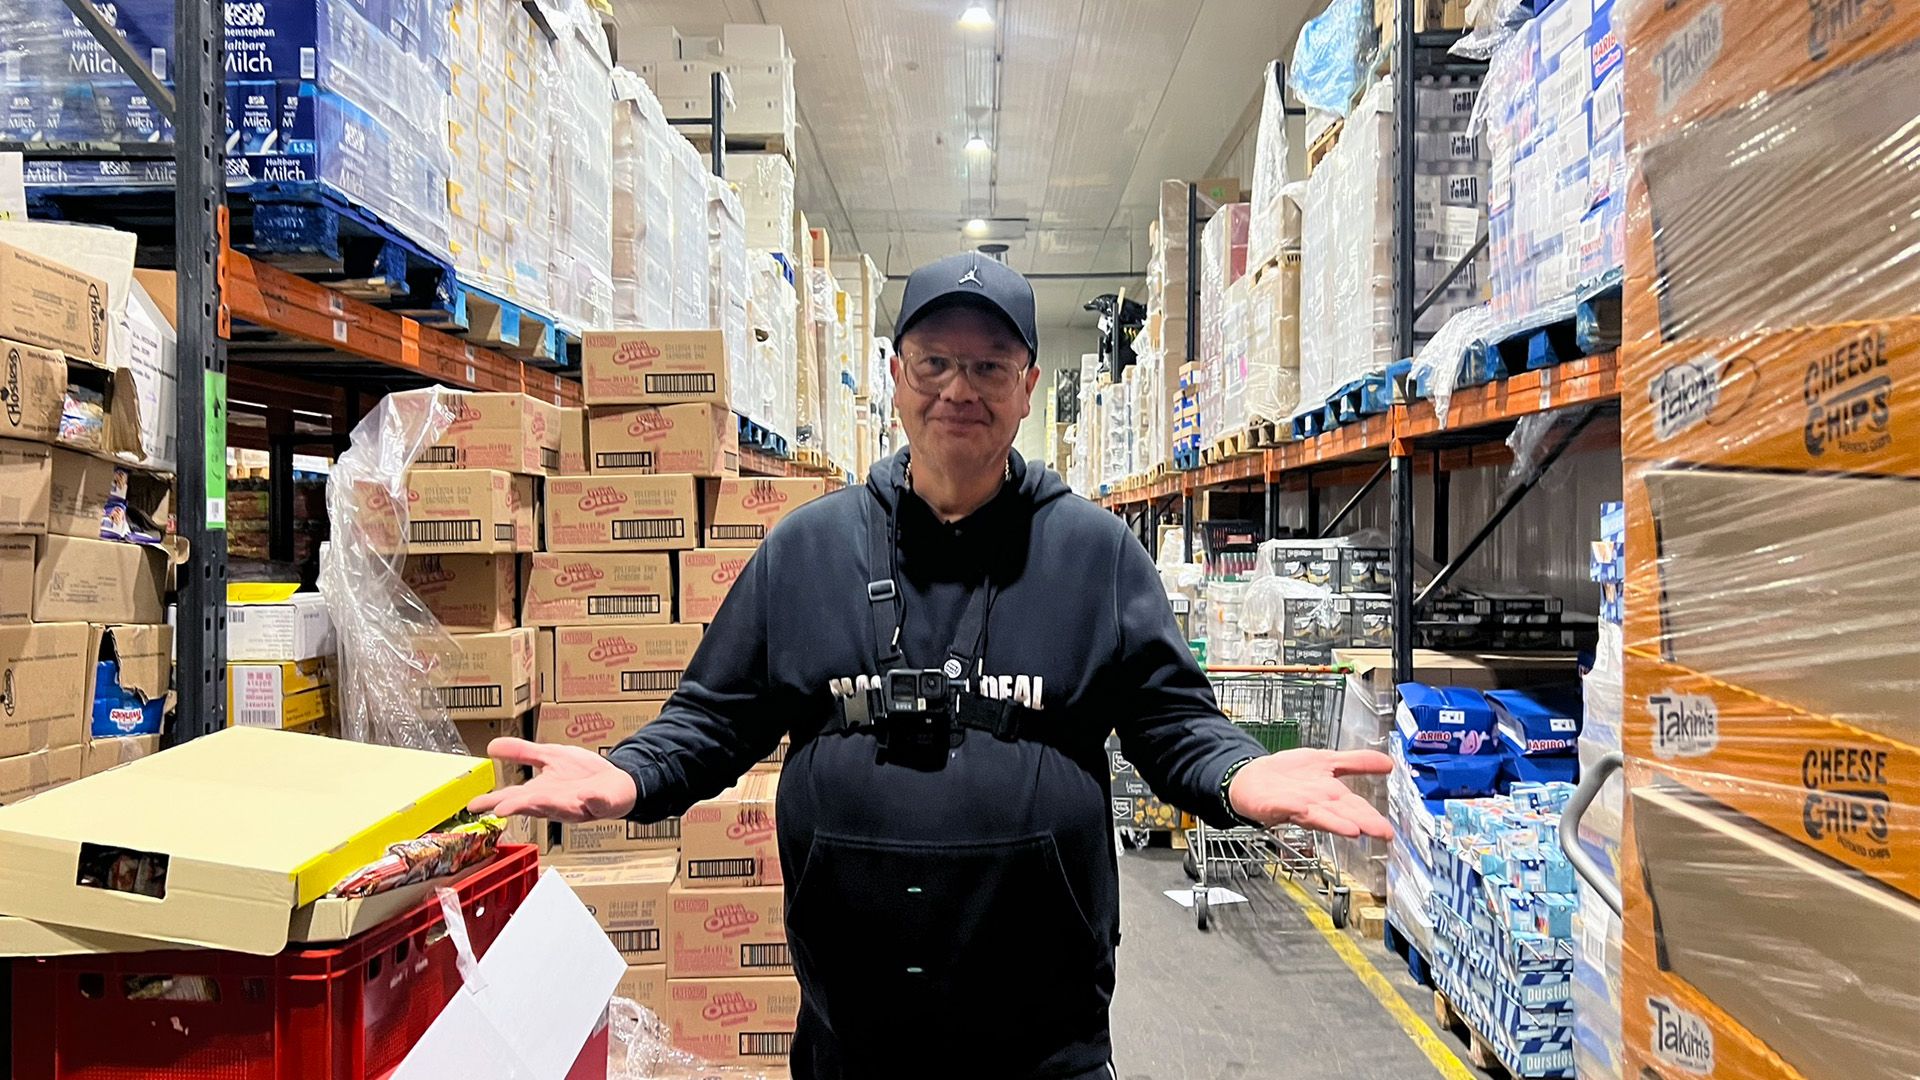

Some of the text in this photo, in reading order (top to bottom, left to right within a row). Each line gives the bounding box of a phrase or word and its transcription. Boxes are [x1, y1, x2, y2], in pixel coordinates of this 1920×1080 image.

[225, 28, 275, 38] henstephan
[243, 115, 271, 128] Milch
[266, 158, 301, 166] Haltbare
[145, 167, 176, 181] Milc
[263, 167, 305, 181] Milch
[613, 347, 661, 365] OREO
[1804, 332, 1889, 405] CHEESE
[7, 352, 21, 417] Hostess
[1805, 392, 1890, 457] CHIPS
[578, 492, 628, 511] OREO
[554, 568, 604, 588] OREO
[588, 643, 638, 662] OREO
[111, 709, 142, 721] Twinkies
[1649, 696, 1714, 747] Takim's
[565, 719, 615, 739] OREO
[1419, 731, 1451, 742] ARIBO
[1803, 748, 1888, 790] CHEESE
[1803, 793, 1889, 840] CHIPS
[704, 911, 759, 933] OREO
[1527, 982, 1570, 1002] Durstlö
[702, 1000, 757, 1021] OREO
[1649, 998, 1710, 1060] Takim's
[1526, 1051, 1574, 1070] Durstlös
